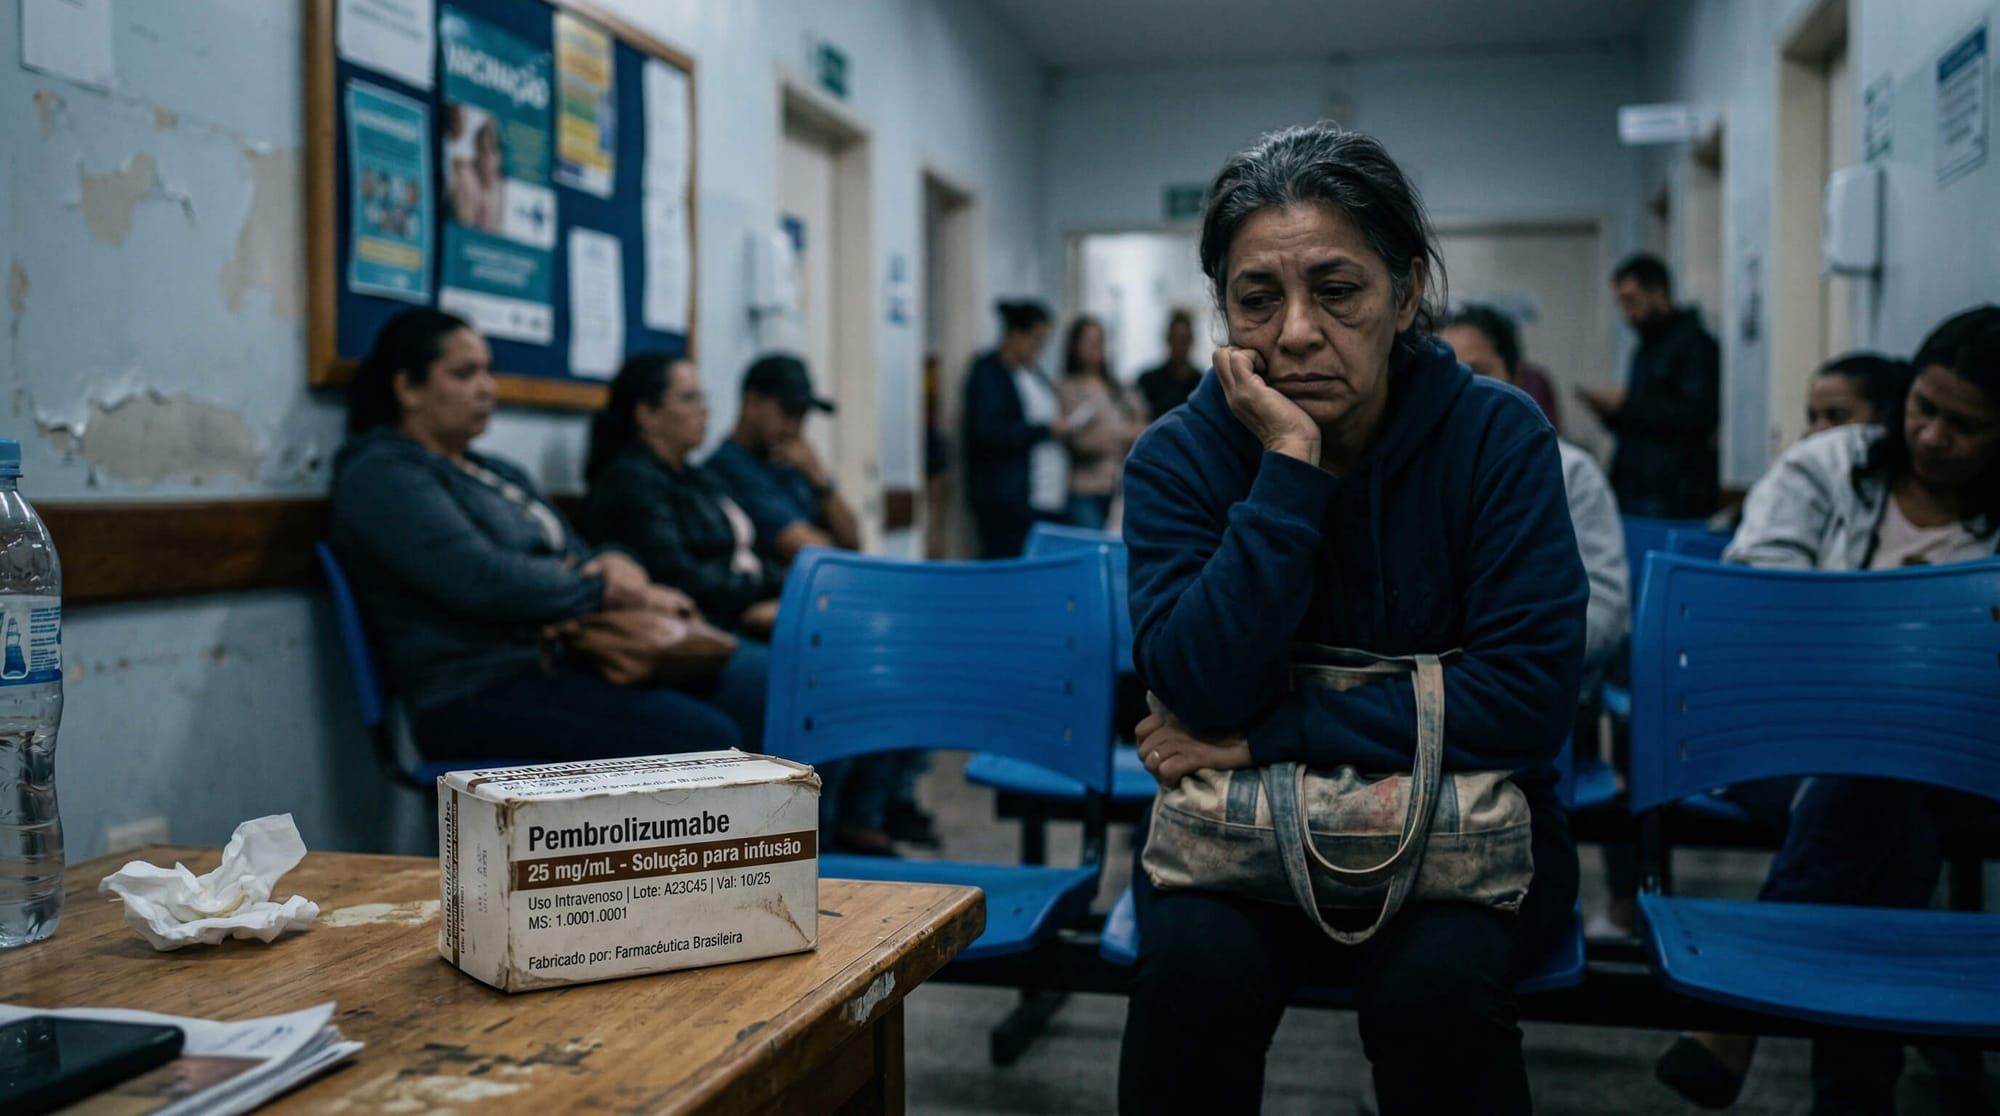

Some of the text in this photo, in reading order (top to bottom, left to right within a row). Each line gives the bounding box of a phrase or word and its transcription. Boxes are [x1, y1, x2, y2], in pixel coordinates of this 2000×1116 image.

[529, 810, 730, 851] Pembrolizumabe
[528, 863, 549, 882] 25
[555, 857, 615, 881] mg/mL
[632, 848, 698, 872] Solução
[703, 847, 739, 868] para
[744, 838, 801, 860] infusão
[528, 897, 552, 910] Uso
[555, 890, 623, 908] Intravenoso
[633, 885, 661, 899] Lote:
[664, 879, 707, 896] A23C45
[717, 875, 737, 890] Val:
[740, 872, 771, 887] 10/25
[528, 906, 627, 930] MS: 1.0001.0001
[528, 952, 586, 970] Fabricado
[589, 950, 612, 965] por:
[693, 932, 743, 949] Brasileira
